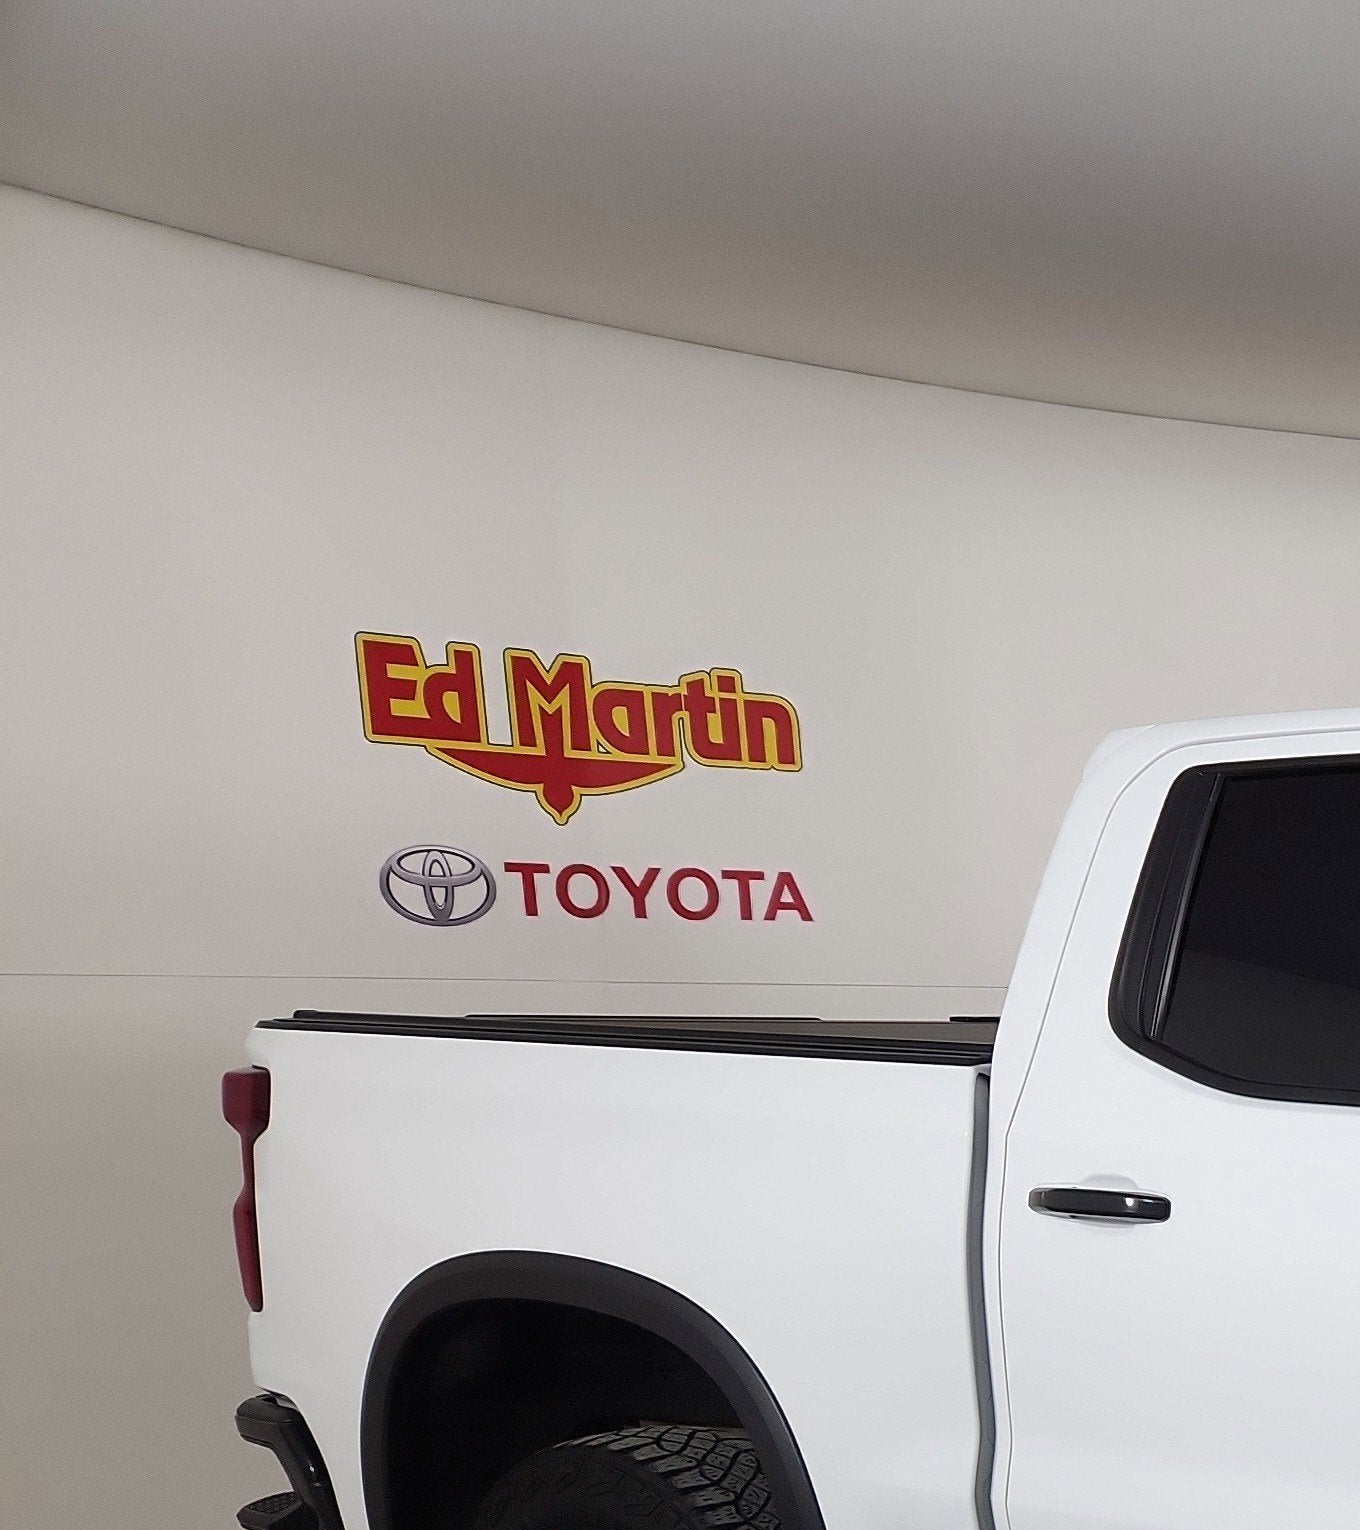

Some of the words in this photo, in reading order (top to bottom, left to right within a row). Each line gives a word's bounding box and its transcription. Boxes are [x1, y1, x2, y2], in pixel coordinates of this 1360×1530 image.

[357, 633, 486, 746] Ed
[504, 649, 801, 771] Martin
[503, 861, 815, 922] TOYOTA
